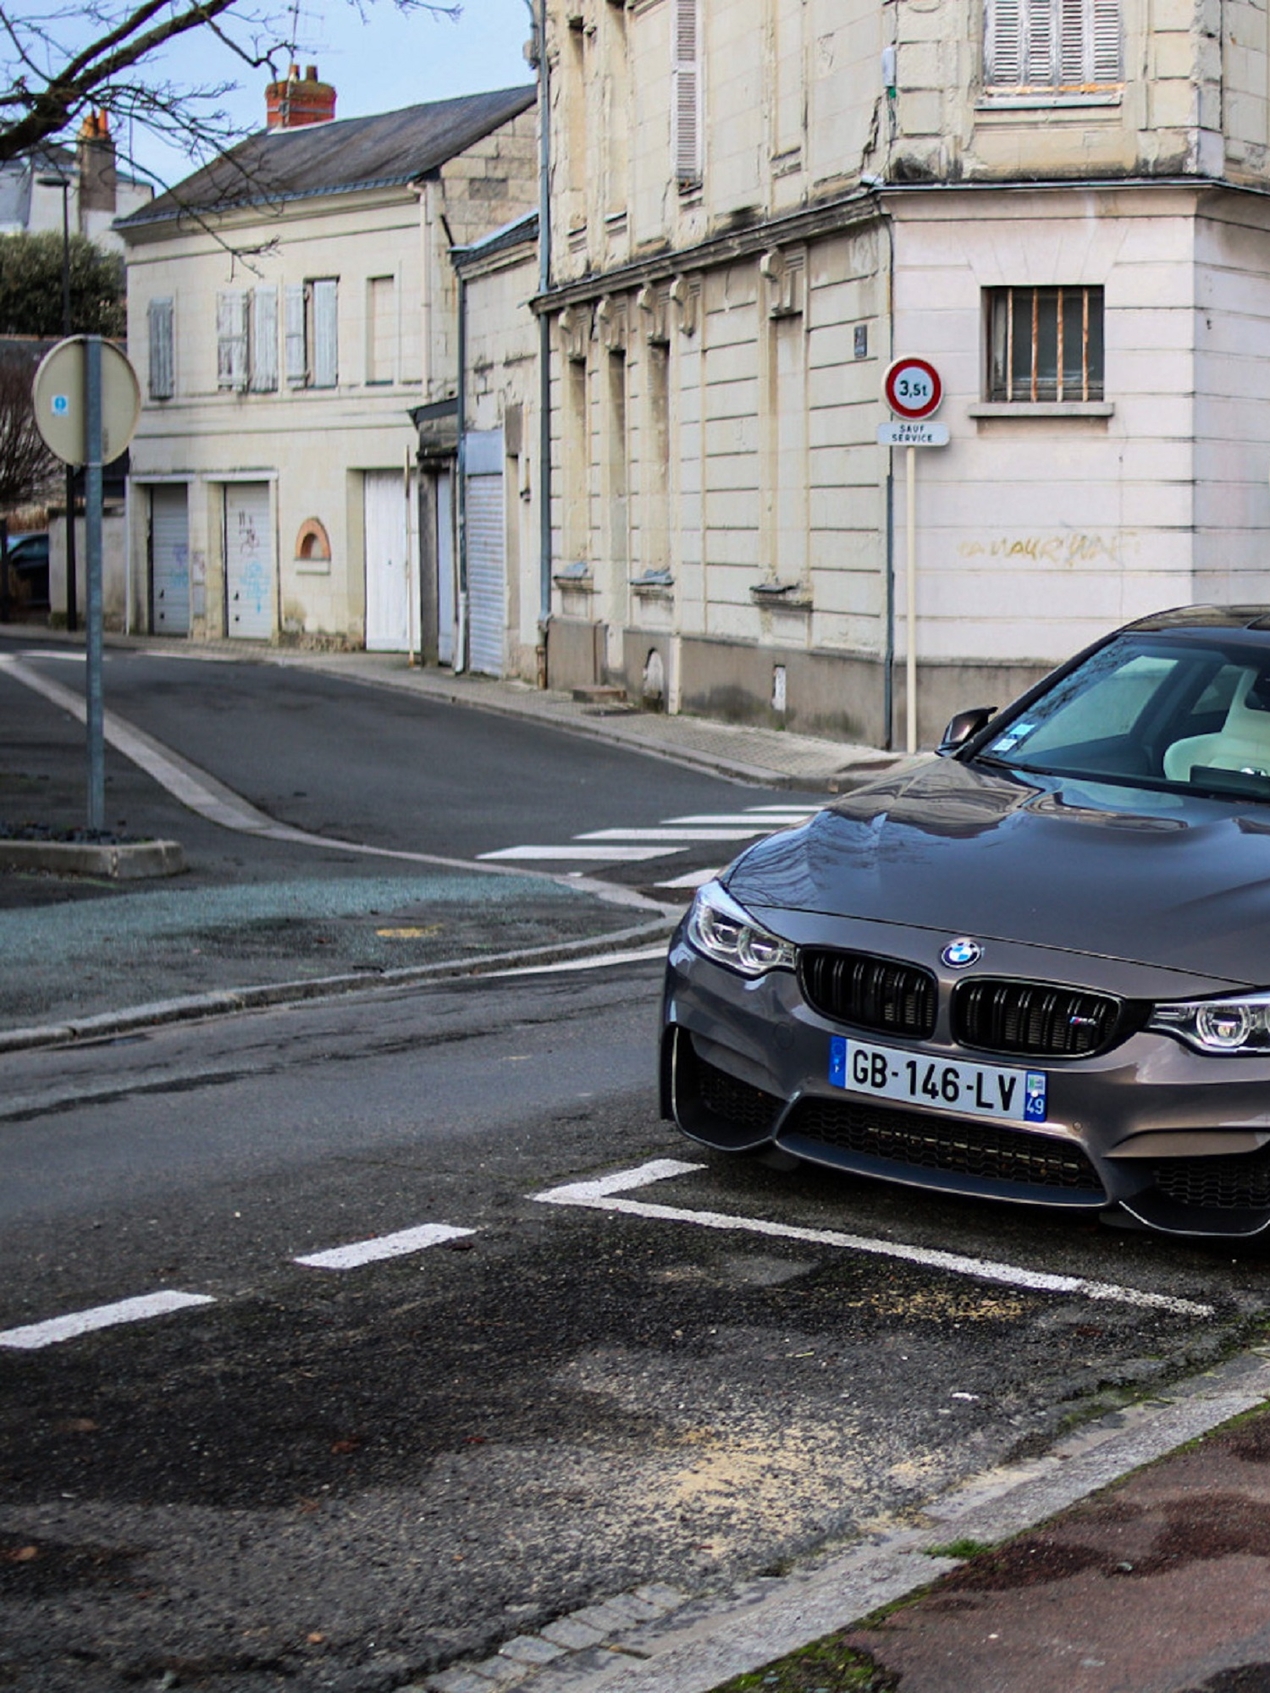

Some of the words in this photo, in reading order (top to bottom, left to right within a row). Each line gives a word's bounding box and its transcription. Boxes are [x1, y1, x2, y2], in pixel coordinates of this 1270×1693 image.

[899, 380, 928, 398] 3,5t
[899, 424, 925, 433] SAUF
[891, 433, 933, 443] SERVICE
[852, 1048, 1017, 1112] GB-146-LV
[1026, 1098, 1044, 1115] 49
